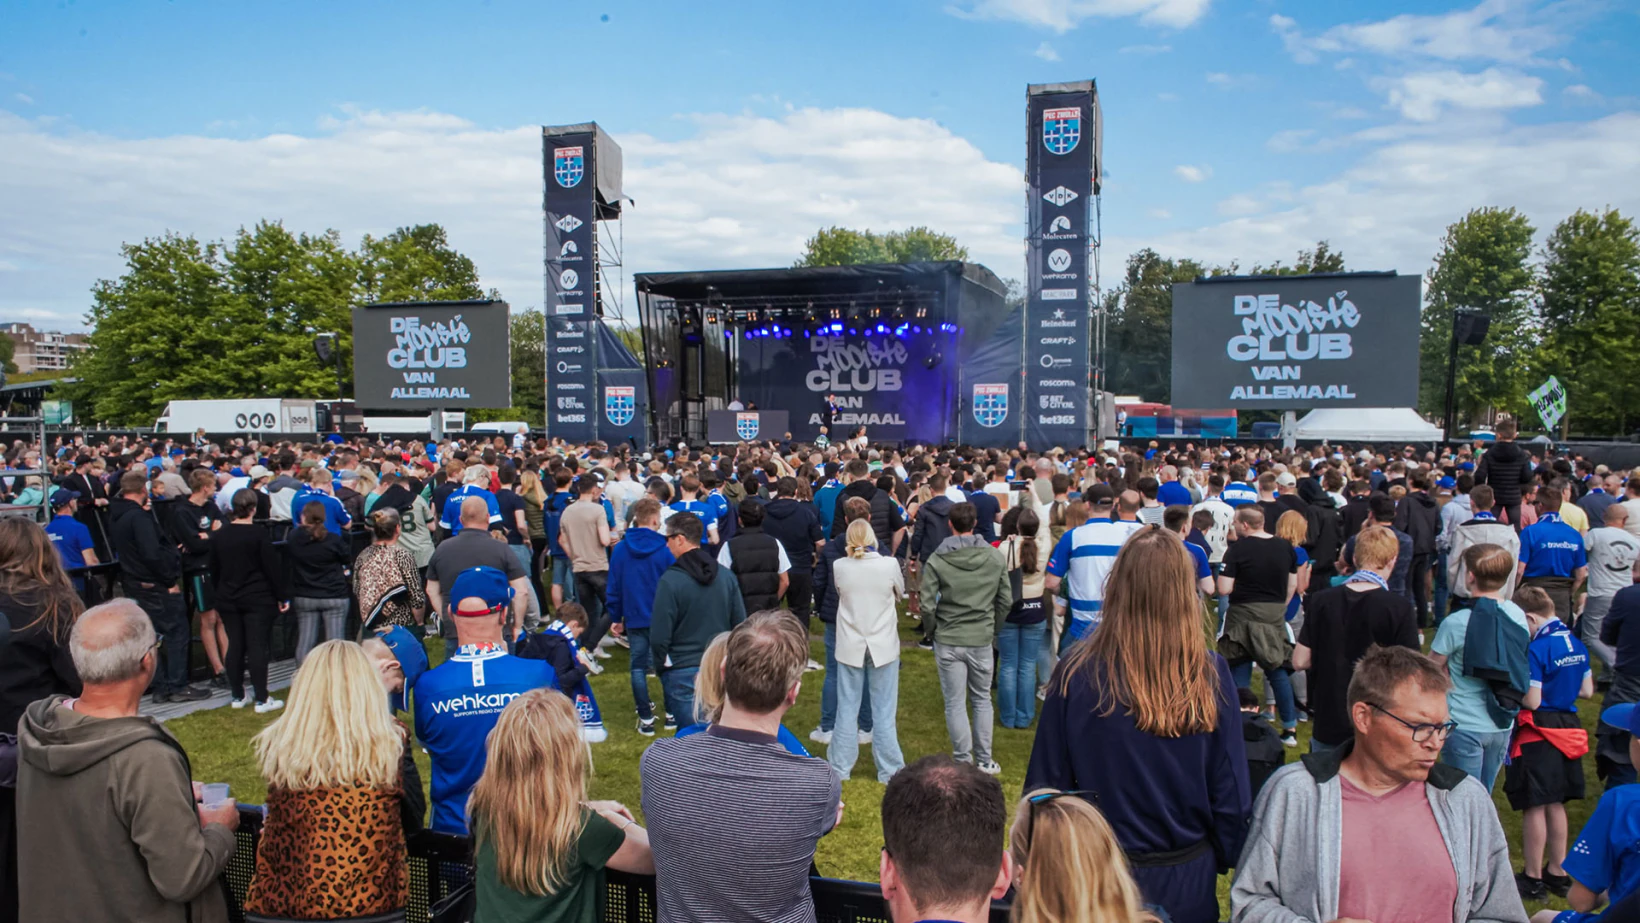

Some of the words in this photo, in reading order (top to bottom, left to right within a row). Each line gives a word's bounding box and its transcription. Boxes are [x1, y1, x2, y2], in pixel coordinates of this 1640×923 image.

[1234, 294, 1280, 315] DE
[390, 317, 419, 333] DE
[810, 336, 845, 352] DE
[1227, 332, 1353, 361] CLUB
[387, 347, 467, 369] CLUB
[403, 372, 434, 383] VAN
[806, 369, 902, 391] CLUB
[1251, 366, 1301, 380] VAN
[391, 387, 470, 398] ALLEMAAL
[1230, 385, 1356, 399] ALLEMAAL
[557, 414, 585, 422] bet365
[809, 413, 905, 424] ALEMAAL
[1040, 415, 1075, 424] bet365
[432, 693, 521, 714] wehkam
[453, 710, 478, 718] SUPPORTS
